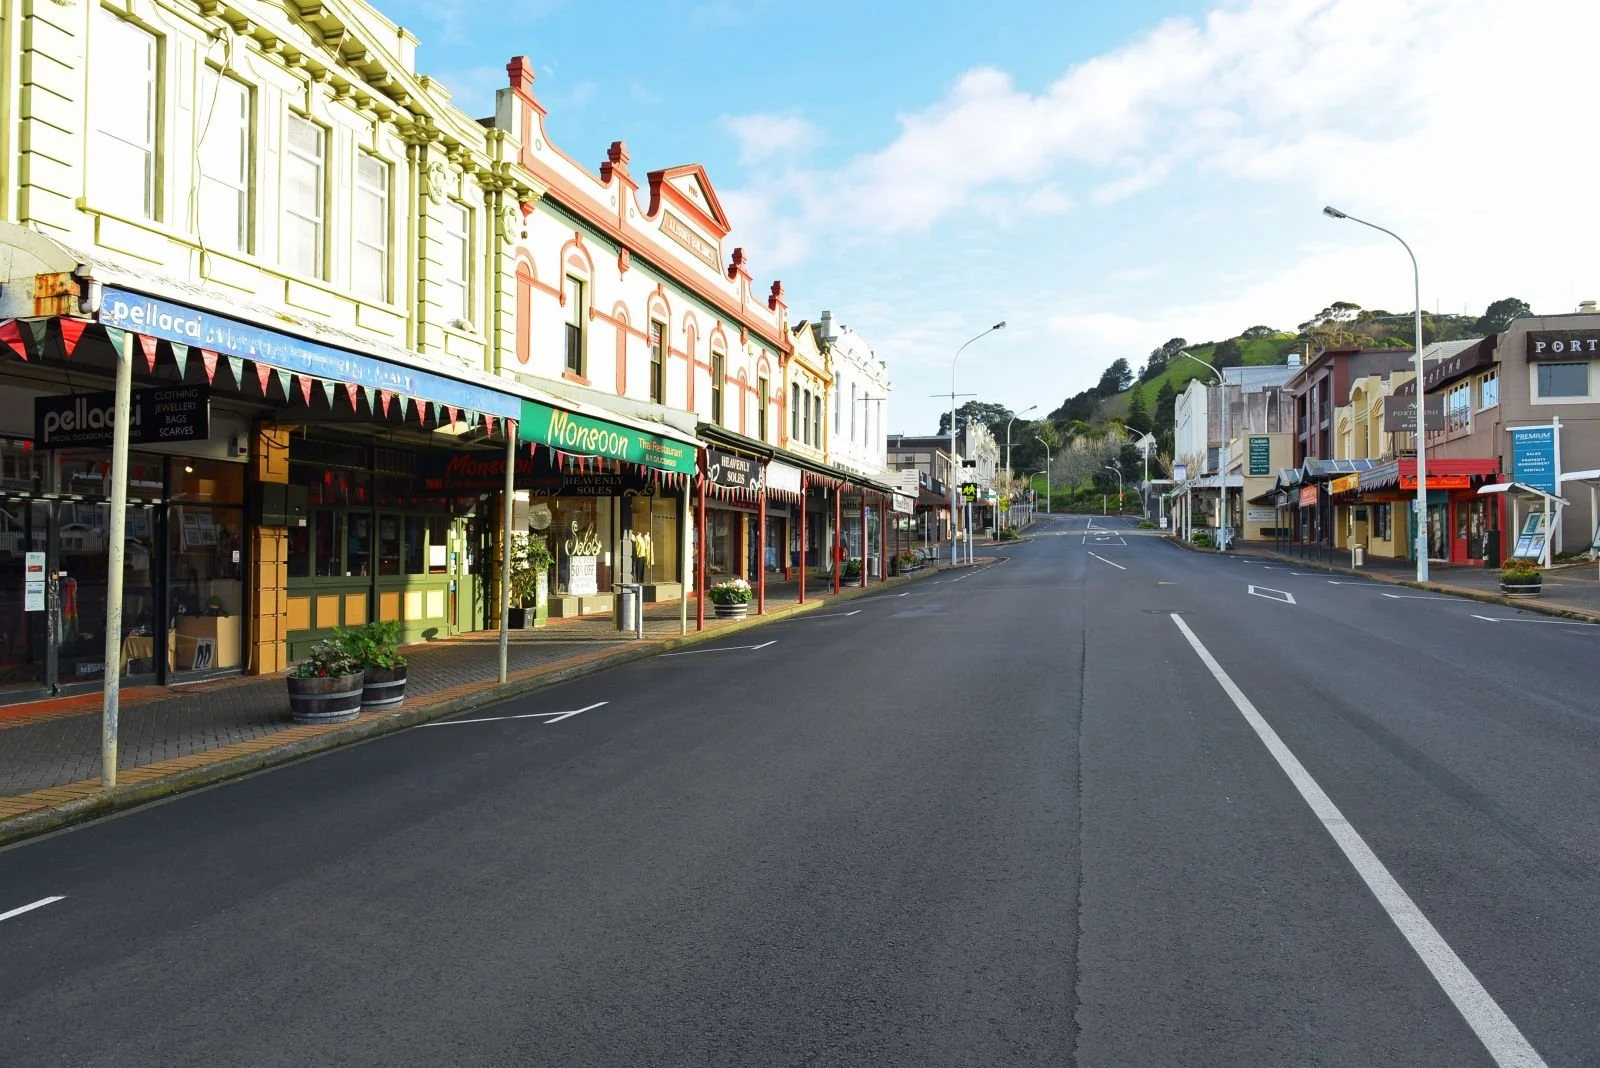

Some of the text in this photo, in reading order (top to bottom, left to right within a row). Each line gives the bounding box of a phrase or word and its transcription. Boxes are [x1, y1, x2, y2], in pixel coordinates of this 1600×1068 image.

[1535, 339, 1598, 353] PORT
[154, 388, 198, 401] CLOTHING
[154, 401, 197, 415] JEWELLERY
[165, 414, 187, 424] BAGS
[159, 425, 195, 437] SCARVES
[547, 409, 629, 459] Monsoon
[1515, 432, 1551, 440] PREMIUM
[638, 436, 683, 459] Thai Restaurant
[721, 456, 750, 473] HEAVENLY
[565, 476, 624, 486] HEAVENLY
[726, 471, 745, 485] SOLES
[577, 486, 613, 496] SOLES
